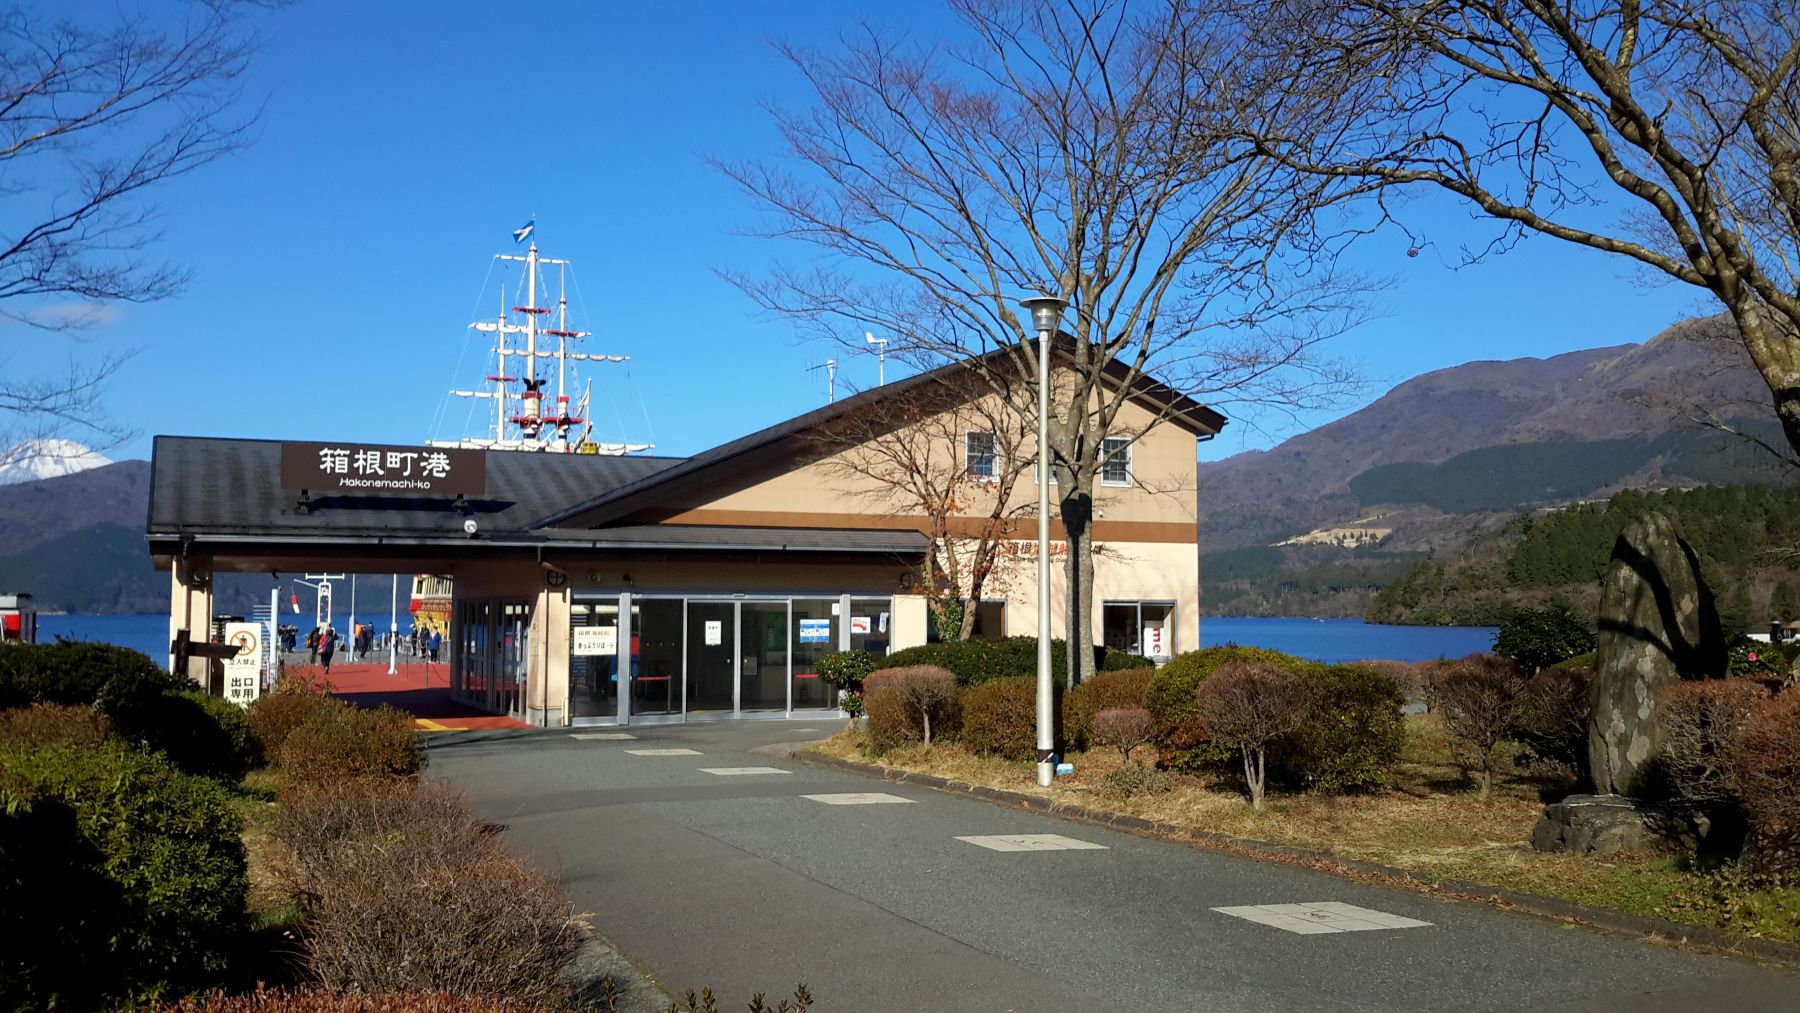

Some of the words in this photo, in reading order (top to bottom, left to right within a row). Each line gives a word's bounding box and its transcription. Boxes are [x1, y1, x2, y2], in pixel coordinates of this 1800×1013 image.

[319, 447, 451, 478] 箱根町港
[339, 477, 431, 489] Hakonemachi-ko
[231, 677, 254, 687] 出口
[231, 688, 254, 699] 専用
